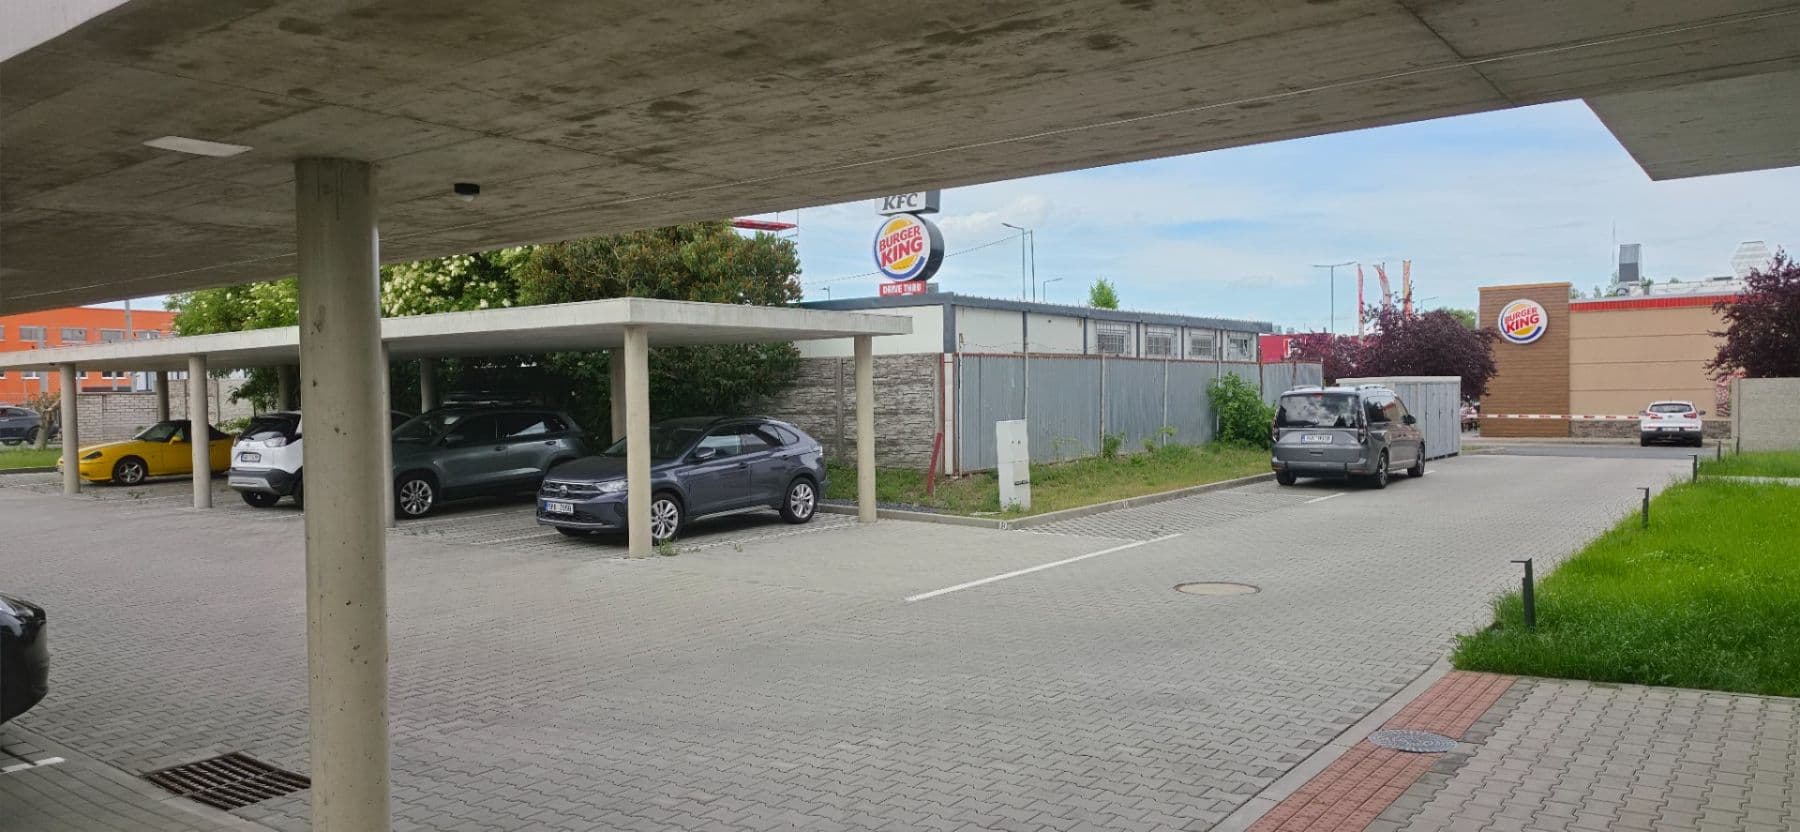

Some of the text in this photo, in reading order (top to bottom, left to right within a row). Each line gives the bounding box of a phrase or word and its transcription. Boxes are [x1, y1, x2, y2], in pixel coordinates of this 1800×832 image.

[882, 192, 918, 210] KFC
[879, 225, 921, 253] BURGER
[881, 237, 923, 269] KING
[1504, 307, 1538, 325] BURGER
[1506, 314, 1540, 333] KING
